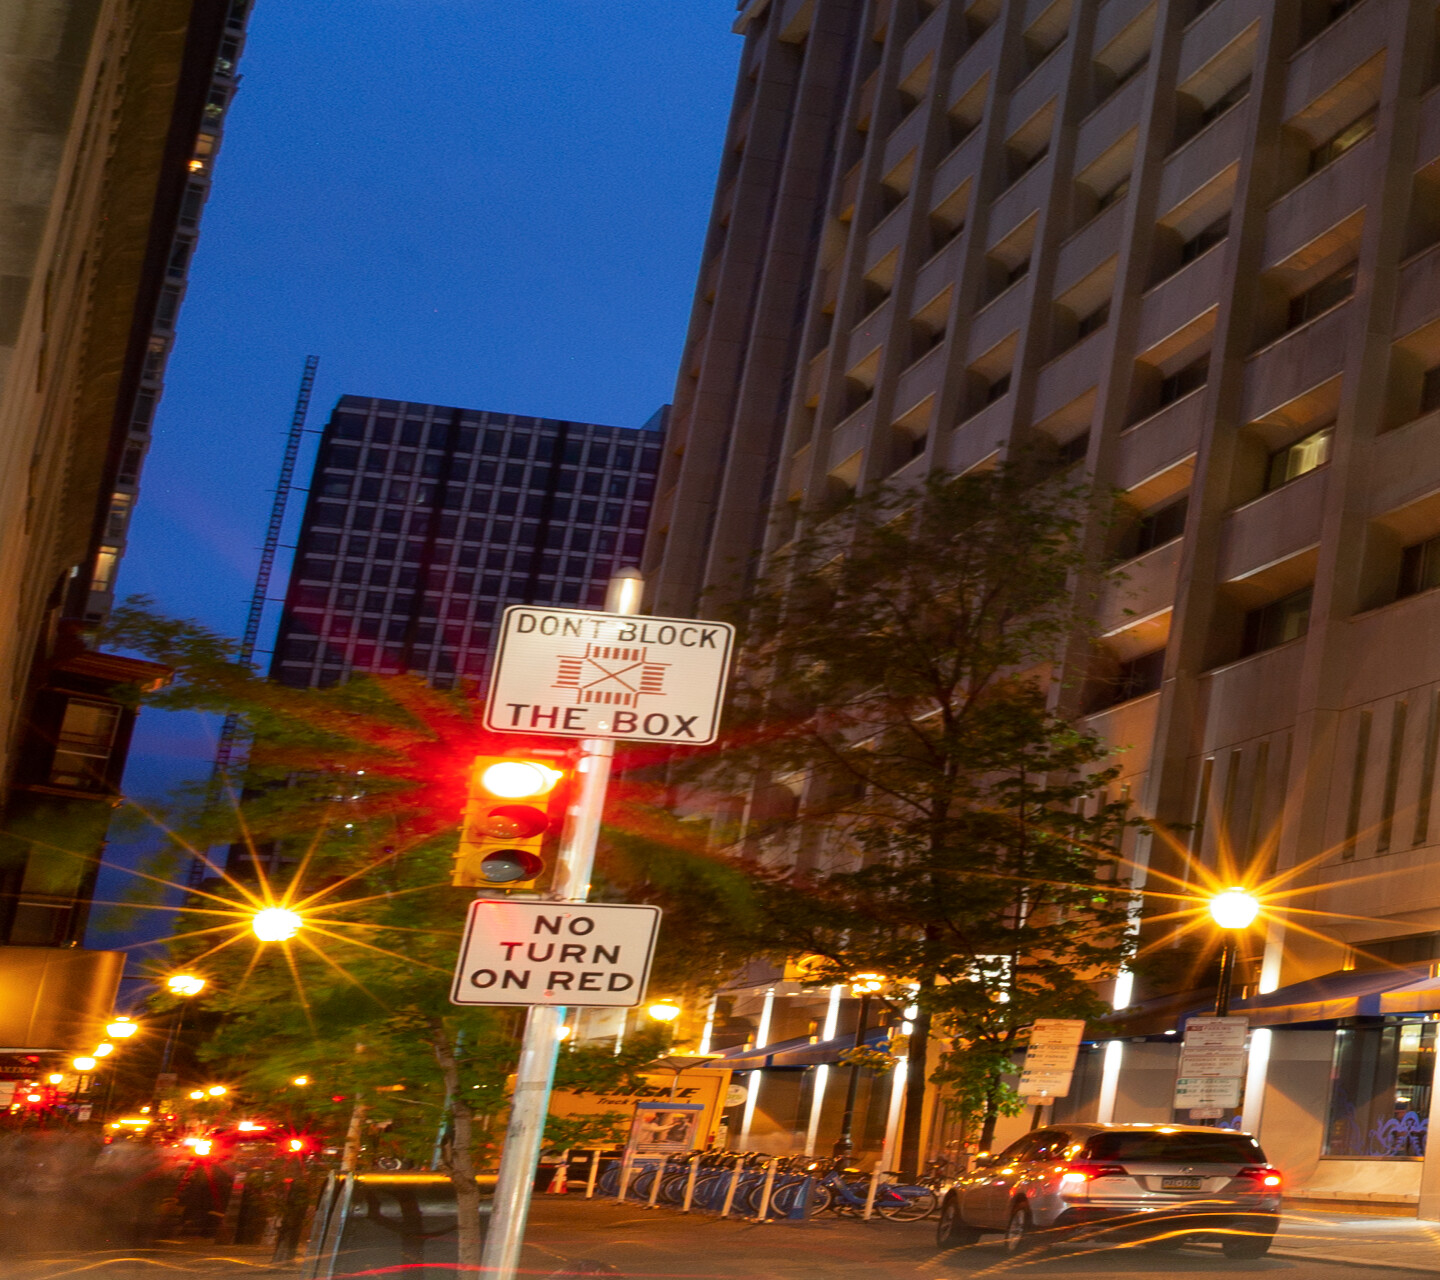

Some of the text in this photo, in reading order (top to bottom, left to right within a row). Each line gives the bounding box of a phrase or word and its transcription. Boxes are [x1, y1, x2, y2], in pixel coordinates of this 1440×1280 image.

[516, 613, 719, 649] DON'T BLOCK
[506, 703, 699, 738] THE BOX
[534, 915, 595, 936] NO
[500, 942, 621, 964] TURN
[471, 969, 634, 991] ON RED
